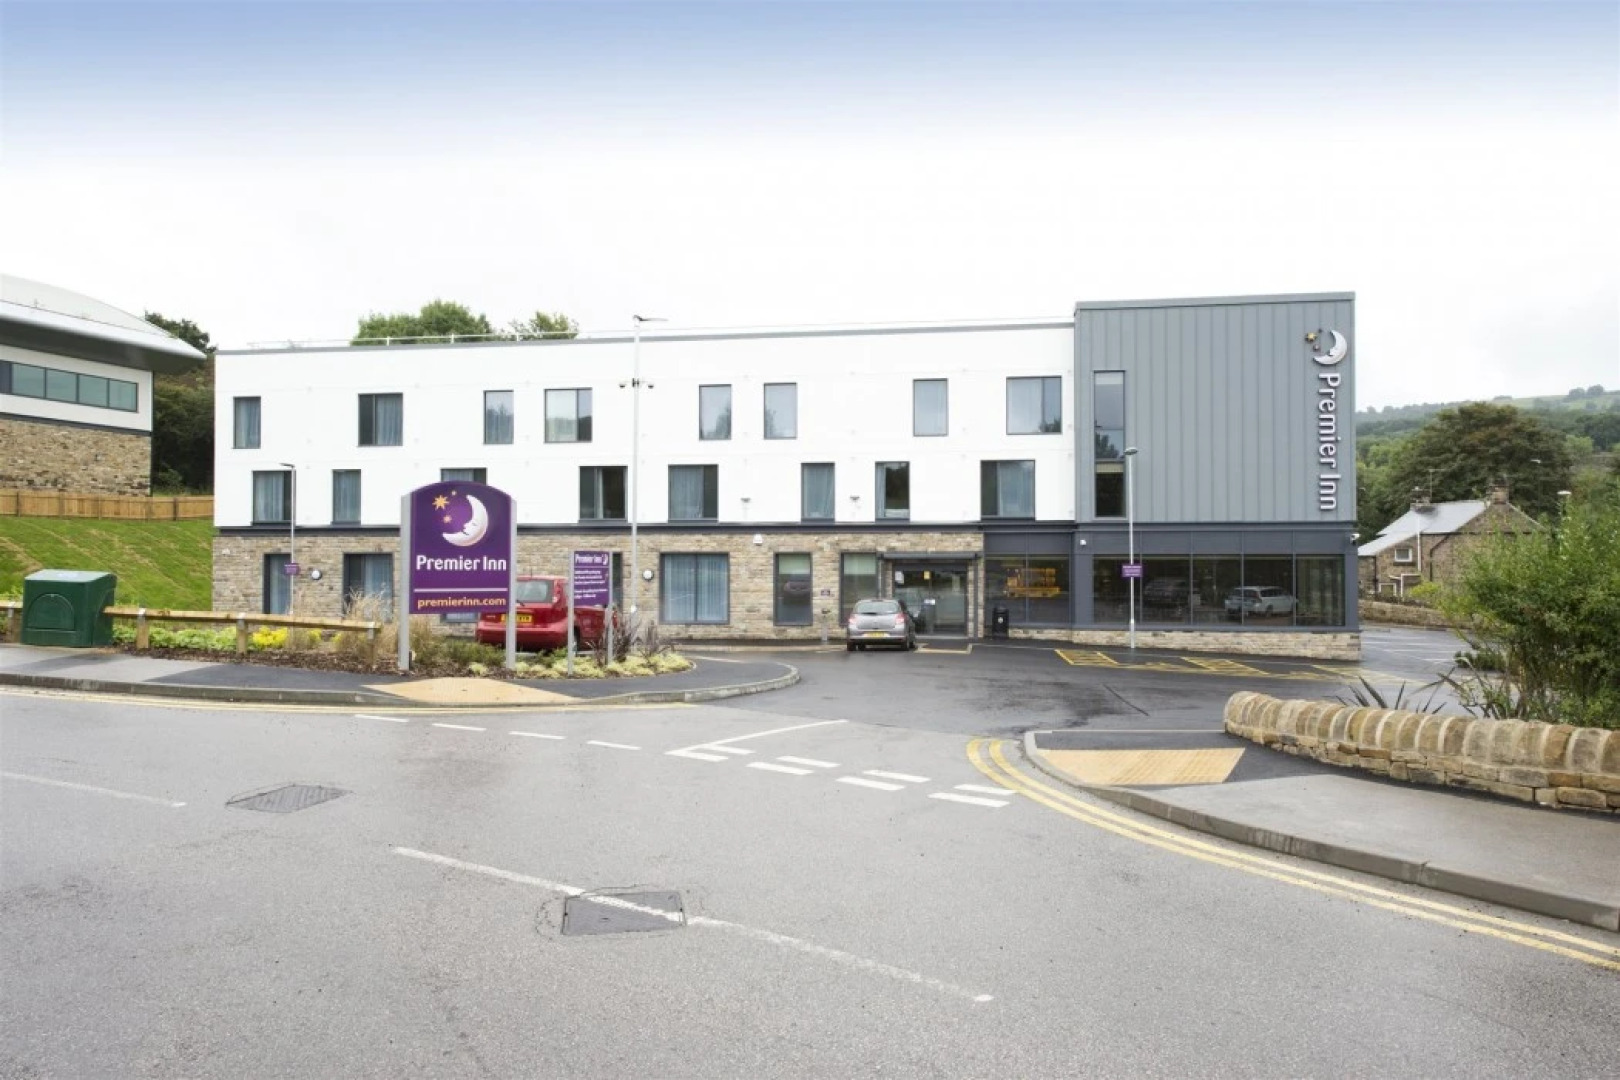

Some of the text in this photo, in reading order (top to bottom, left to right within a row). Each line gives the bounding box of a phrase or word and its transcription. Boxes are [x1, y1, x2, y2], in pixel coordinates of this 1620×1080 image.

[1318, 373, 1342, 510] Premier Inn
[416, 554, 507, 571] Premier Inn
[417, 596, 507, 610] premierinn.com
